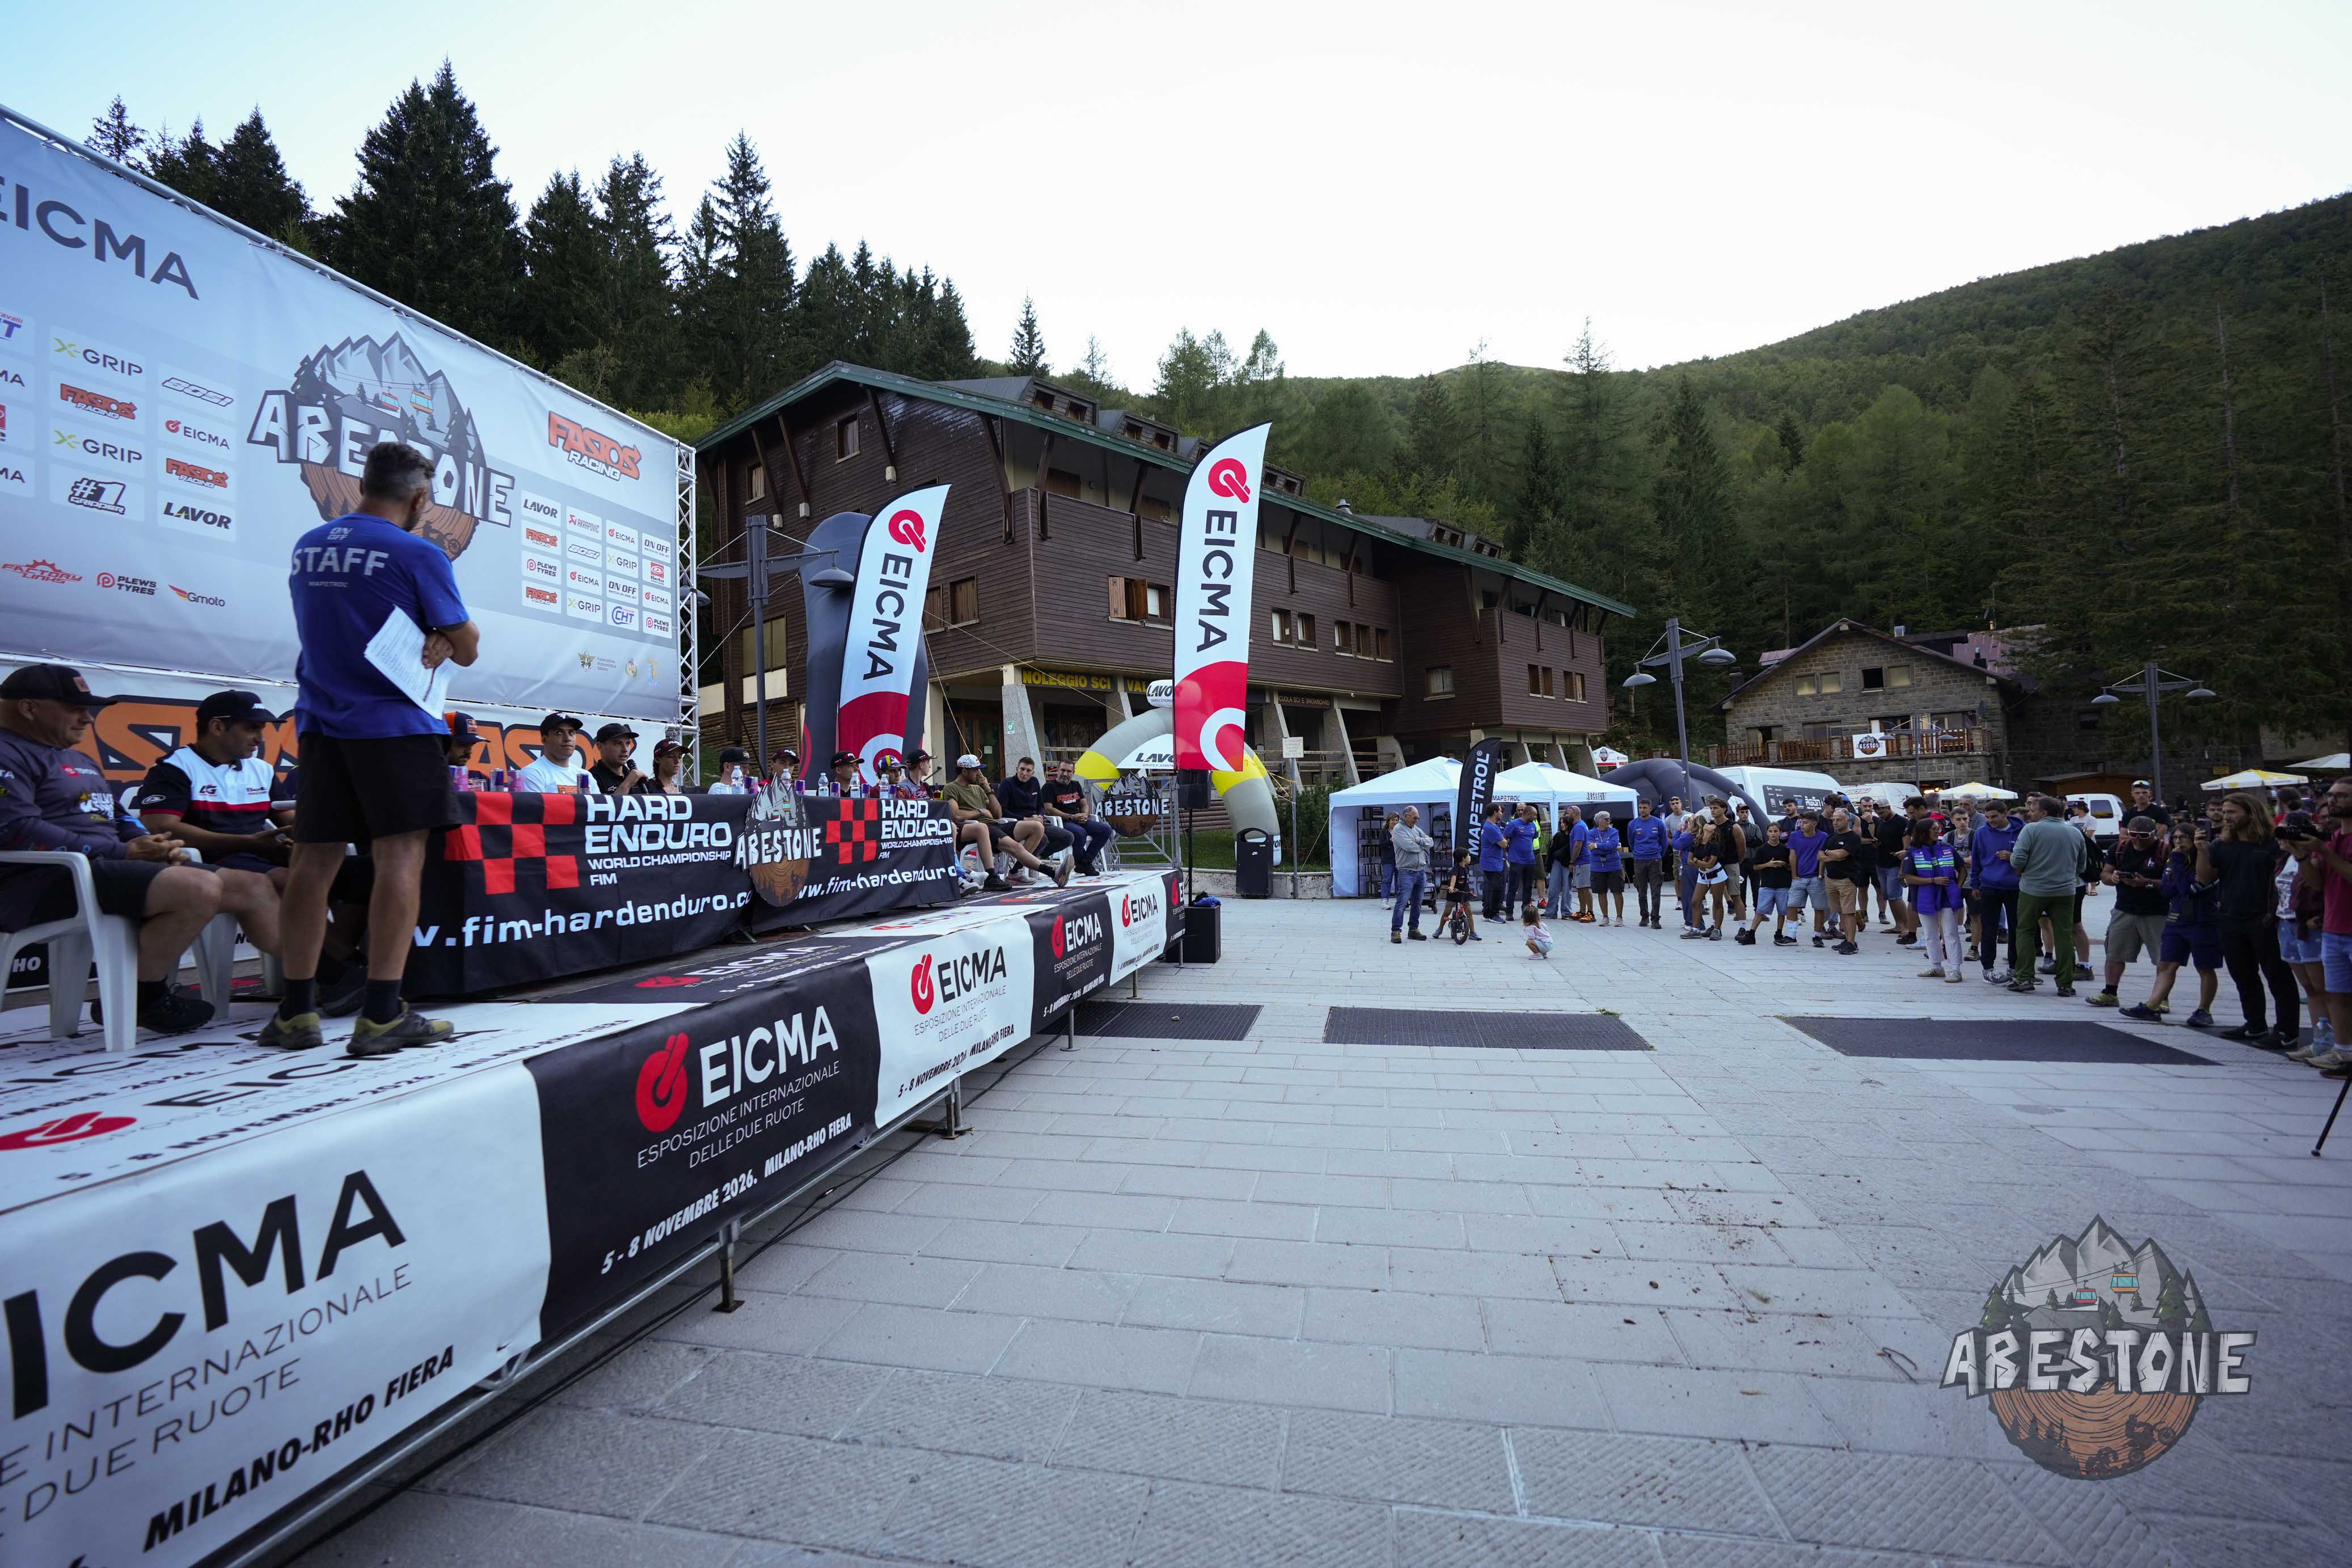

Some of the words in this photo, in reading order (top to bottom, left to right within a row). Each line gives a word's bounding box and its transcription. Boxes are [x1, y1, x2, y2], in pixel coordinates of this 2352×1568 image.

[0, 176, 199, 301] ICMA
[61, 383, 137, 420] FASTOS
[75, 403, 120, 419] RACING
[183, 425, 230, 450] EICMA
[548, 411, 642, 480] FASTOS
[247, 390, 514, 527] ABEONE
[567, 449, 621, 481] RACING
[166, 458, 229, 488] FASTOS
[179, 475, 215, 489] RACING
[69, 495, 126, 515] GRIPPER
[163, 502, 232, 529] LAVOR
[523, 499, 558, 518] LAVOR
[615, 532, 635, 545] EICMA
[644, 539, 656, 549] ON
[656, 543, 670, 553] OFF
[1, 564, 83, 581] FACTORY
[292, 547, 389, 576] STAFF
[537, 561, 557, 572] PLEWS
[537, 567, 556, 577] TYRES
[22, 572, 67, 584] LINKS
[117, 576, 157, 588] PLEWS
[117, 584, 155, 595] TYRES
[577, 574, 599, 586] EICMA
[609, 581, 620, 591] ON
[622, 585, 636, 595] OFF
[1196, 510, 1238, 653] EICMA
[187, 591, 226, 607] Gmoto
[651, 594, 669, 605] EICMA
[863, 553, 913, 681] EICMA
[1022, 671, 1087, 688] NOLEGGIO
[1091, 677, 1112, 690] SCI
[584, 794, 692, 822] HARD
[881, 800, 929, 818] HARD
[1095, 798, 1171, 818] ABESTONE
[584, 822, 732, 854] ENDURO
[881, 818, 952, 839] ENDURO
[734, 826, 822, 870] ABESTONE
[878, 851, 890, 860] FIM
[881, 840, 903, 850] WORLD
[903, 837, 953, 848] CHAMPIONSHIP
[588, 856, 640, 870] WORLD
[641, 851, 731, 867] CHAMPIONSHIP
[590, 873, 618, 886] FIM
[1131, 894, 1158, 923] EICMA
[1065, 912, 1103, 952] EICMA
[683, 945, 833, 976] EICMA
[1054, 954, 1076, 973] ESPOSIZIONE
[1076, 943, 1103, 962] INTERNAZIONALE
[938, 946, 1007, 1003] EICMA
[1066, 967, 1076, 980] DELLE
[914, 1006, 961, 1036] ESPOSIZIONE
[961, 985, 1007, 1015] INTERNAZIONALE
[1044, 1007, 1048, 1017] 5
[1049, 1003, 1053, 1014] 8
[939, 1024, 959, 1042] DELLE
[960, 1015, 973, 1031] DUE
[974, 1007, 987, 1026] RUOTE
[699, 1005, 839, 1108] EICMA
[898, 1084, 904, 1098] 5
[909, 1078, 915, 1092] 8
[915, 1060, 952, 1088] NOVEMBRE
[1000, 1024, 1014, 1041] FIERA
[167, 1097, 357, 1149] NOVEMBRE
[358, 1072, 446, 1096] 2026.
[450, 1033, 583, 1068] MILANO-RHO
[579, 1020, 634, 1033] FIERA
[637, 1106, 737, 1169] ESPOSIZIONE
[739, 1060, 840, 1118] INTERNAZIONALE
[689, 1136, 734, 1169] DELLE
[735, 1118, 763, 1143] DUE
[765, 1097, 805, 1130] RUOTE
[601, 1250, 616, 1275] 5
[627, 1236, 641, 1259] 8
[643, 1189, 719, 1249] NOVEMBRE
[721, 1169, 758, 1203] 2026.
[764, 1129, 826, 1178] MILANO-RHO
[828, 1112, 852, 1140] FIERA
[3, 1169, 407, 1421] ICMA
[47, 1262, 412, 1461] INTERNAZIONALE
[23, 1439, 136, 1522] DUE
[153, 1358, 301, 1455] RUOTE
[142, 1393, 375, 1553] MILANO-RHO
[383, 1343, 455, 1408] FIERA
